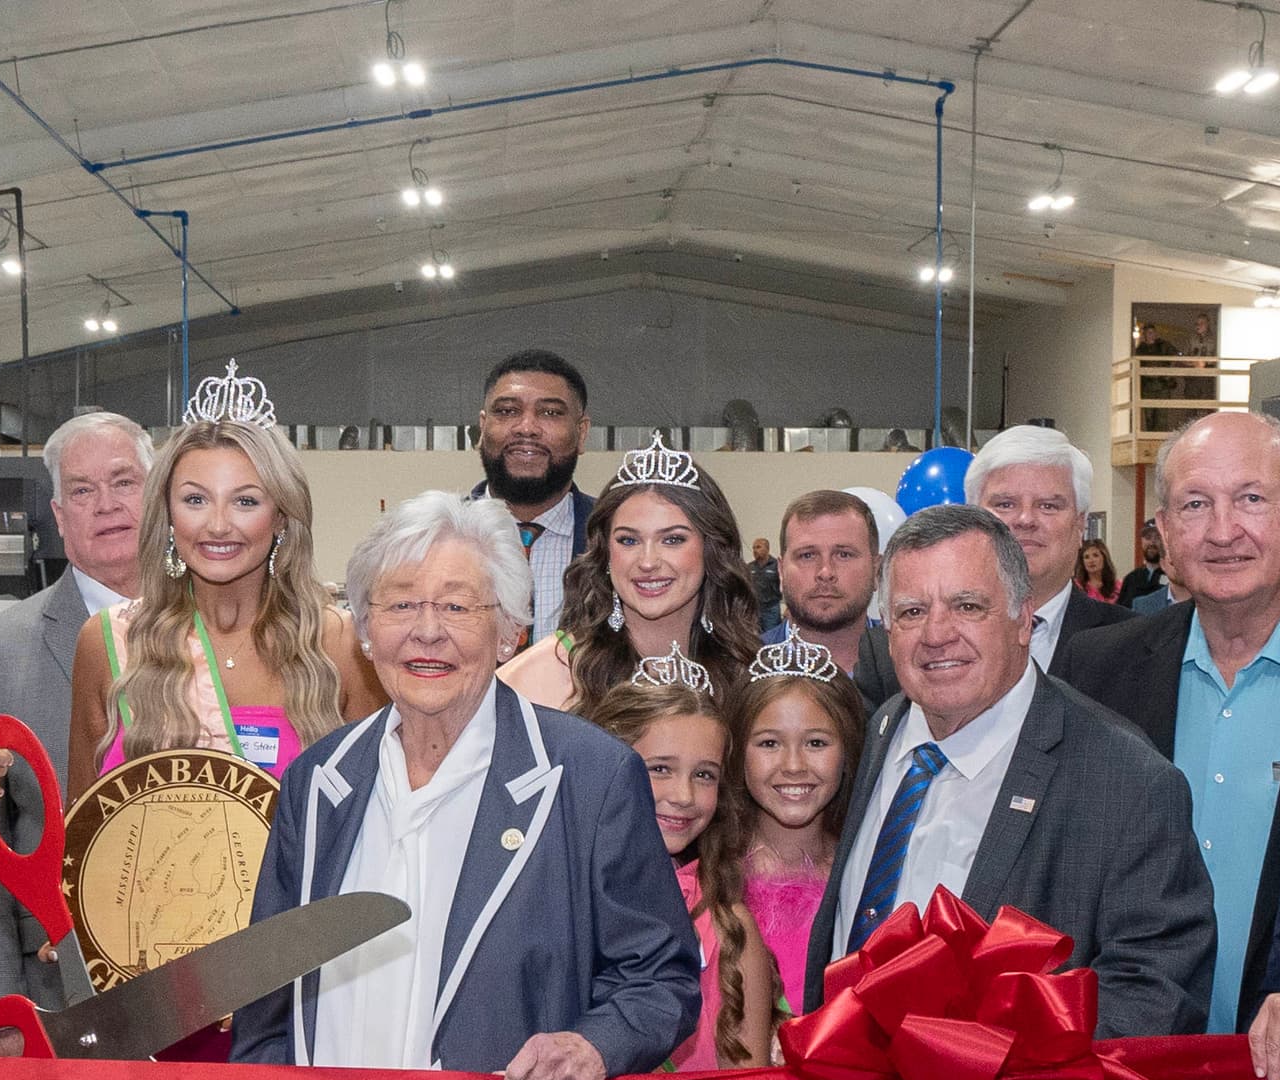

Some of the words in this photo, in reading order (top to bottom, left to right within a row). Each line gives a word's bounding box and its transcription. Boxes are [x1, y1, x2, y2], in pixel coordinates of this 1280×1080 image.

[97, 757, 276, 820] ALABAMA
[151, 793, 219, 802] TENNESSEE
[115, 824, 139, 908] MISSISSIPPI
[231, 831, 252, 893] GEORGIA
